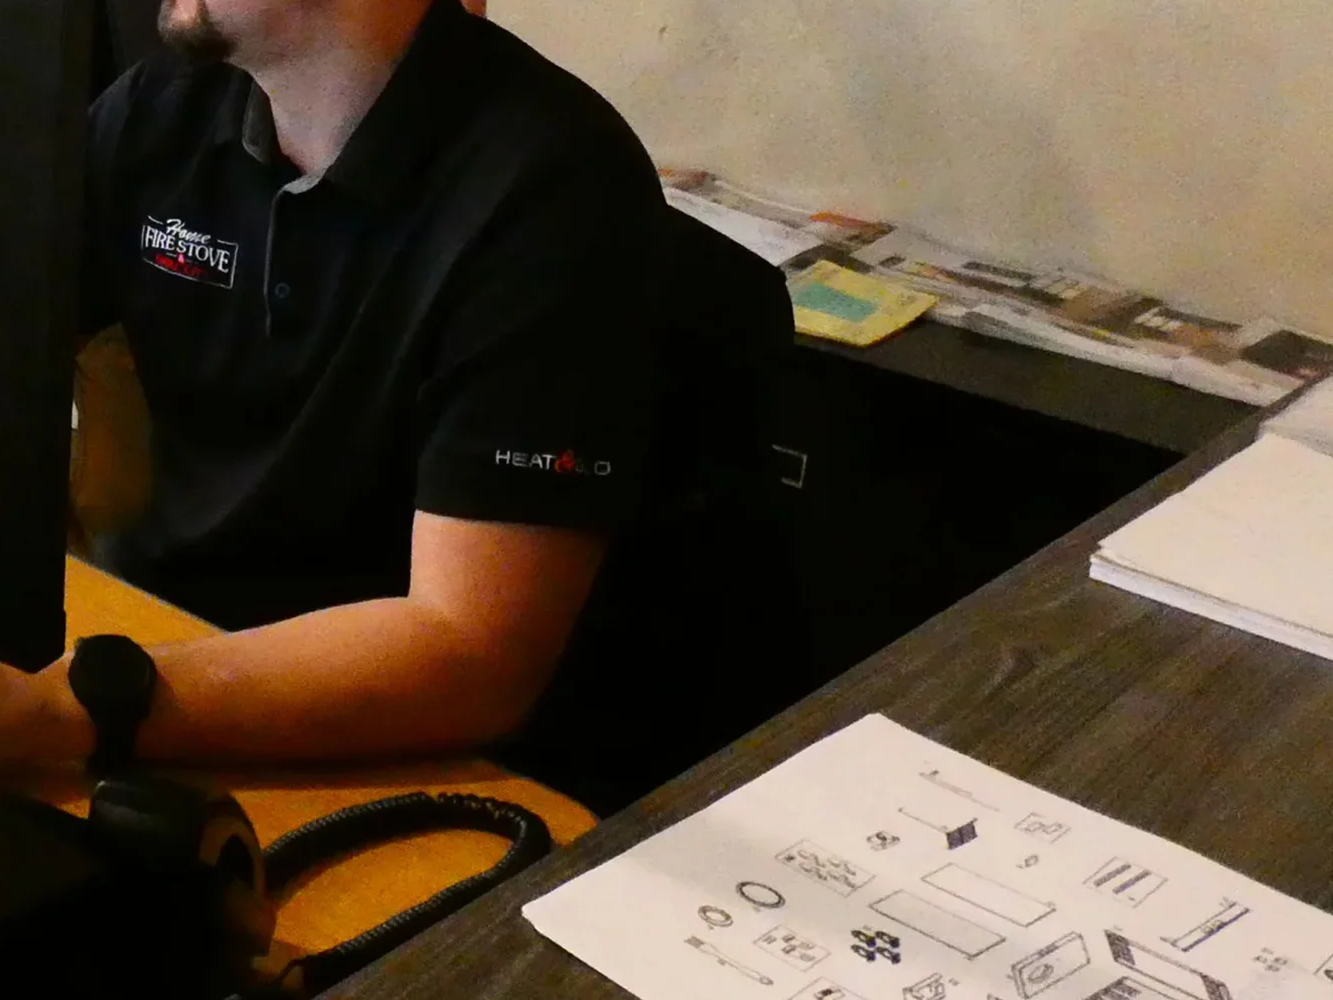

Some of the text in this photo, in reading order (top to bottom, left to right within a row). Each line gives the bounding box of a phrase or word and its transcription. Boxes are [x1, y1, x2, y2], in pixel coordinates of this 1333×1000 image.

[166, 218, 211, 245] Home
[145, 225, 176, 251] FIRE
[176, 240, 230, 273] STOVE
[495, 449, 555, 471] HEAT
